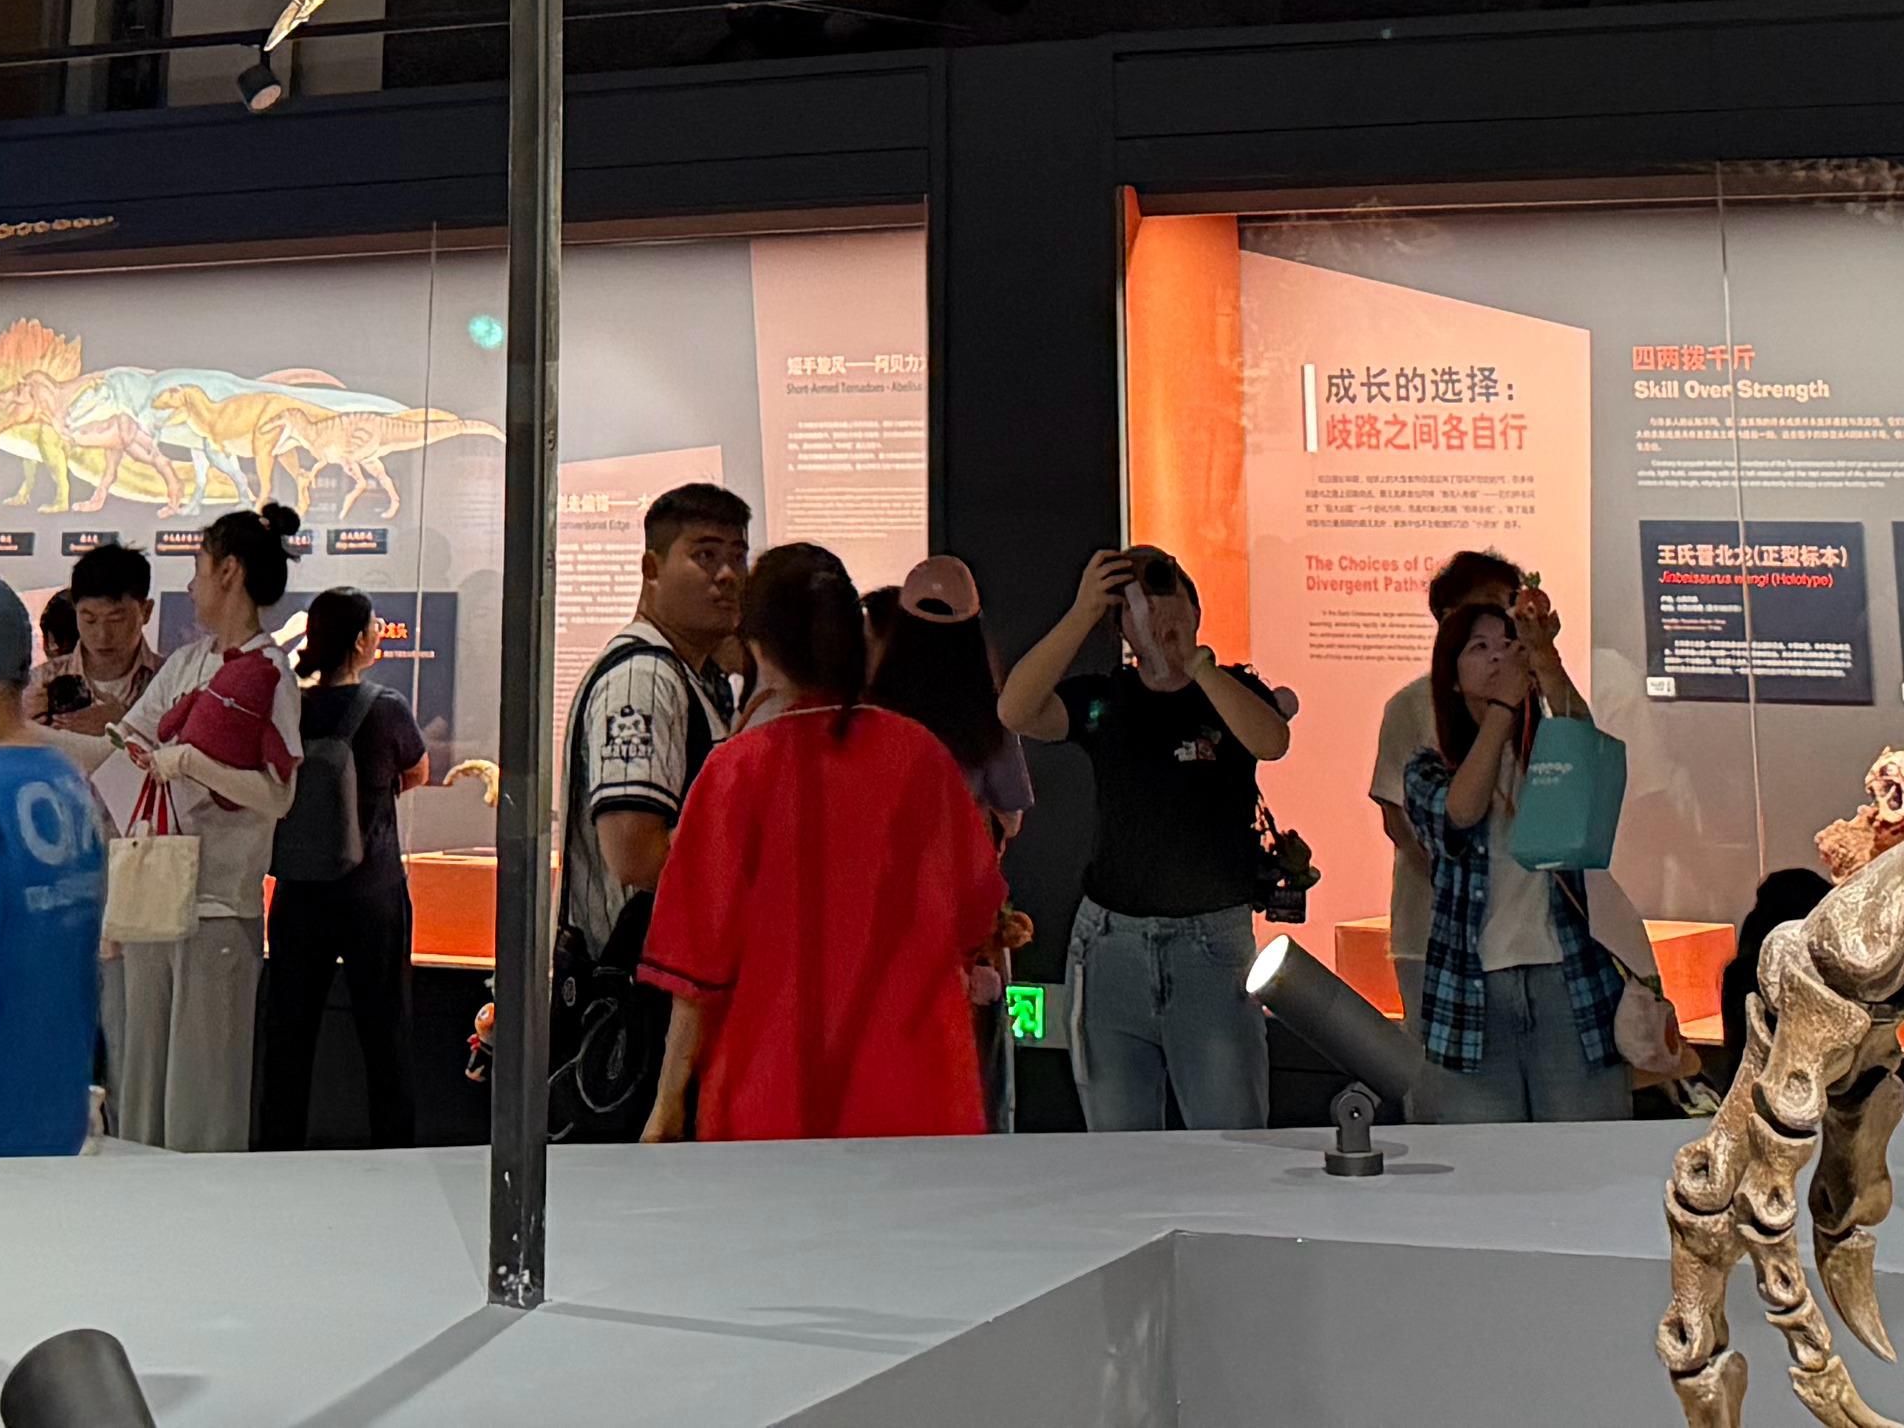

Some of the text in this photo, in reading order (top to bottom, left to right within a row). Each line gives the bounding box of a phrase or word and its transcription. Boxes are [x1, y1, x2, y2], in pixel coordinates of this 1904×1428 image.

[1632, 344, 1756, 372] 四两拨千斤
[1634, 379, 1830, 403] Skill Over Strength
[1326, 413, 1527, 451] 歧路之间各自行
[1305, 555, 1333, 571] The
[1338, 555, 1399, 571] Choices
[1404, 555, 1420, 571] of
[1306, 576, 1429, 595] Divergent Paths
[1734, 572, 1770, 588] wngi
